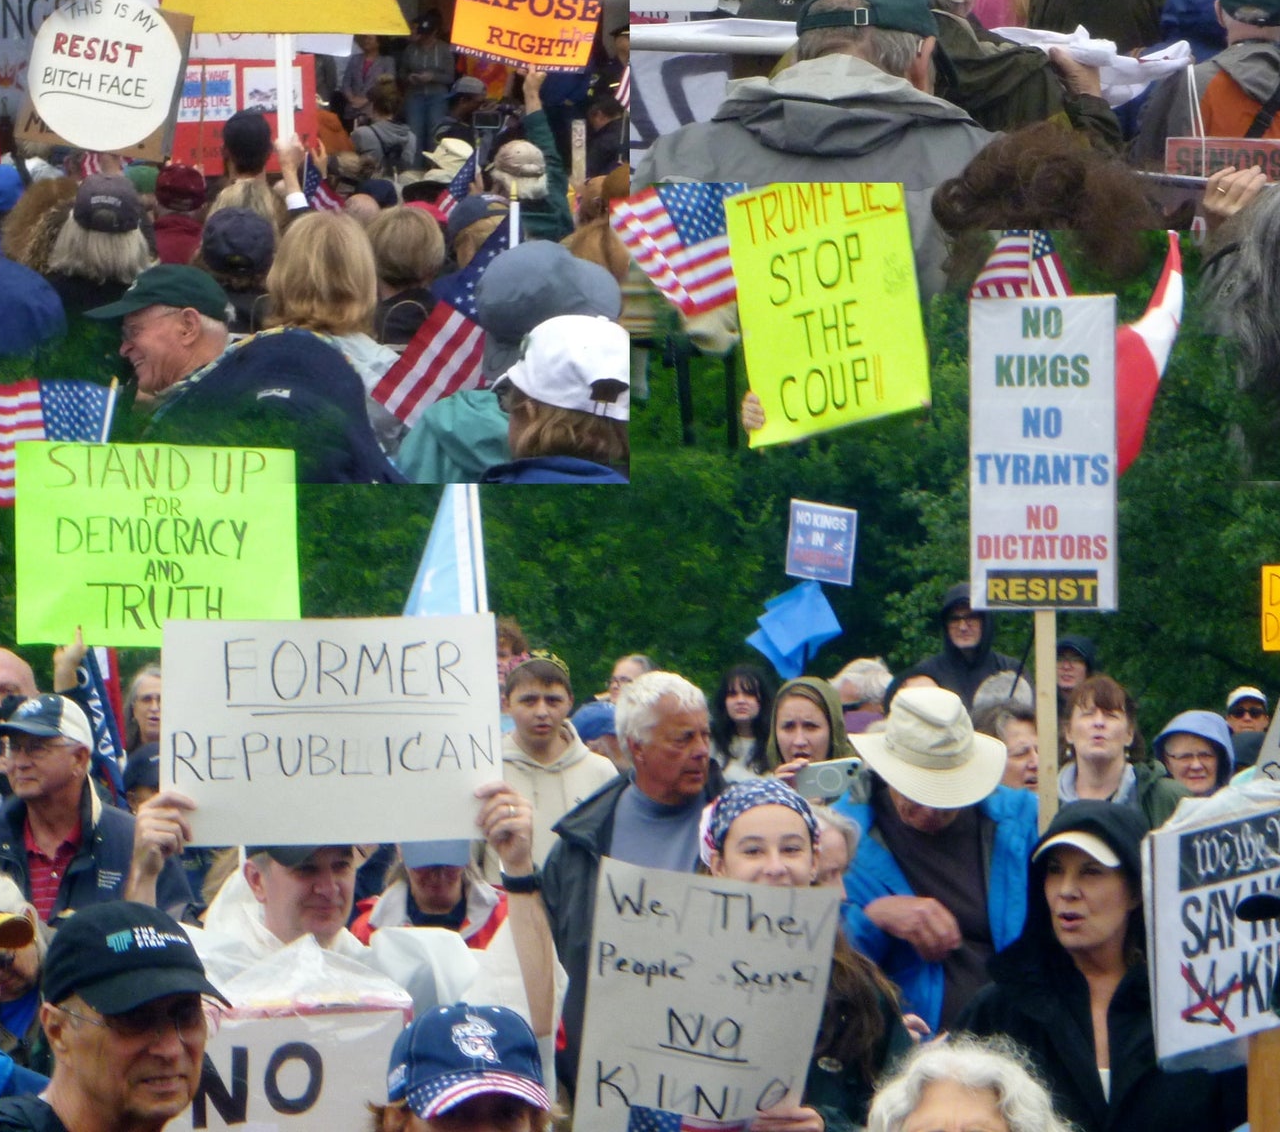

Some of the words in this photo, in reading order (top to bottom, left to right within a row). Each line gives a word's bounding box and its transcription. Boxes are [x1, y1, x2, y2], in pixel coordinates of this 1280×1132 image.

[114, 1, 128, 18] IS
[132, 8, 159, 35] MY
[52, 31, 143, 69] RESIST
[486, 26, 580, 57] RIGHT!
[42, 66, 92, 95] BITCH
[97, 73, 147, 98] FACE
[769, 233, 861, 307] STOP
[794, 300, 862, 359] THE
[1021, 307, 1062, 339] NO
[995, 355, 1090, 388] KINGS
[1022, 407, 1062, 438] NO
[47, 445, 190, 491] STAND
[211, 449, 266, 494] UP
[975, 453, 1110, 486] TYRANTS
[144, 495, 182, 516] FOR
[1025, 505, 1058, 530] NO
[56, 517, 248, 560] DEMOCRACY
[977, 534, 1108, 561] DICTATORS
[144, 559, 184, 584] AND
[987, 576, 1098, 602] RESIST
[86, 581, 222, 631] TRUTH
[223, 638, 471, 702] FORMER
[172, 726, 494, 784] REPUBLICAN
